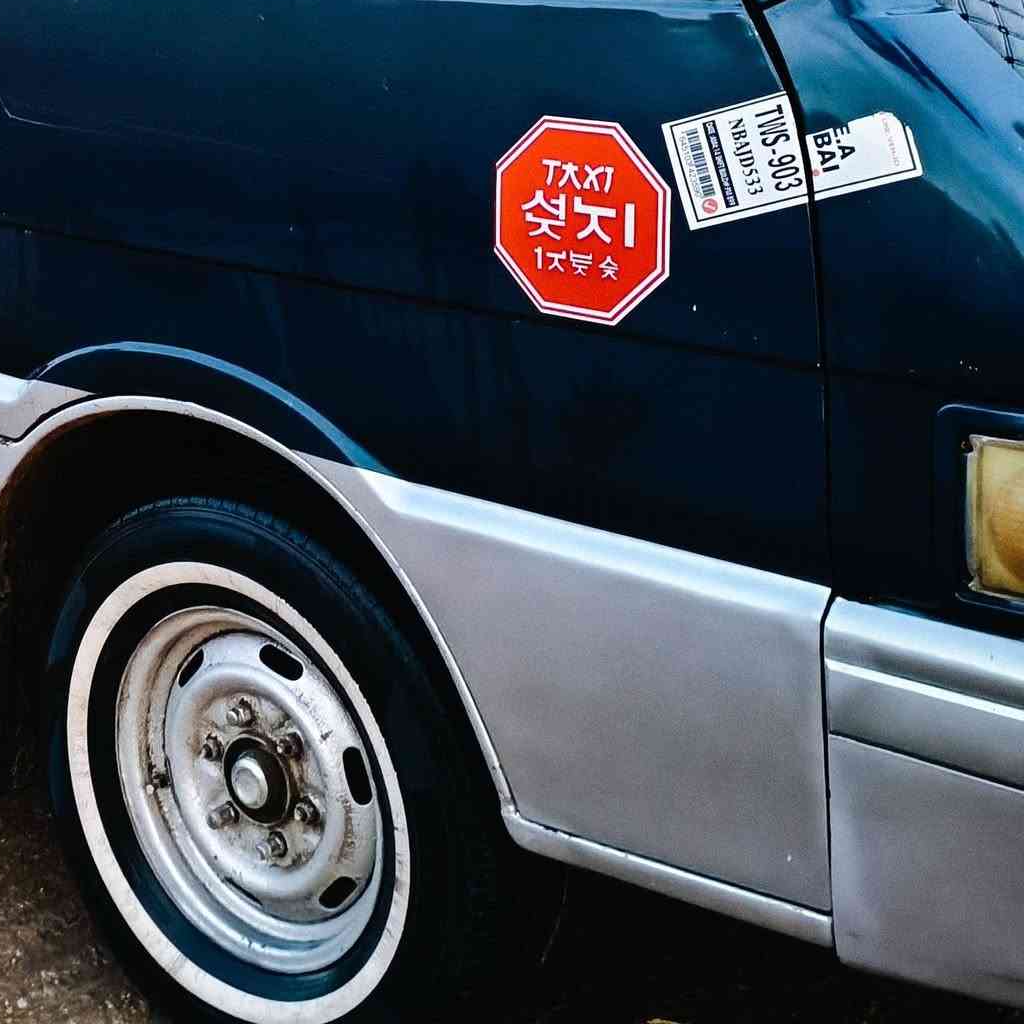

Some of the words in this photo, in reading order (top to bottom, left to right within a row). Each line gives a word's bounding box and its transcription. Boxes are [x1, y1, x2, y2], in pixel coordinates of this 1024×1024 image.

[541, 159, 615, 193] TAXI
[728, 117, 763, 196] NBAJD533
[754, 103, 803, 192] TWS-903
